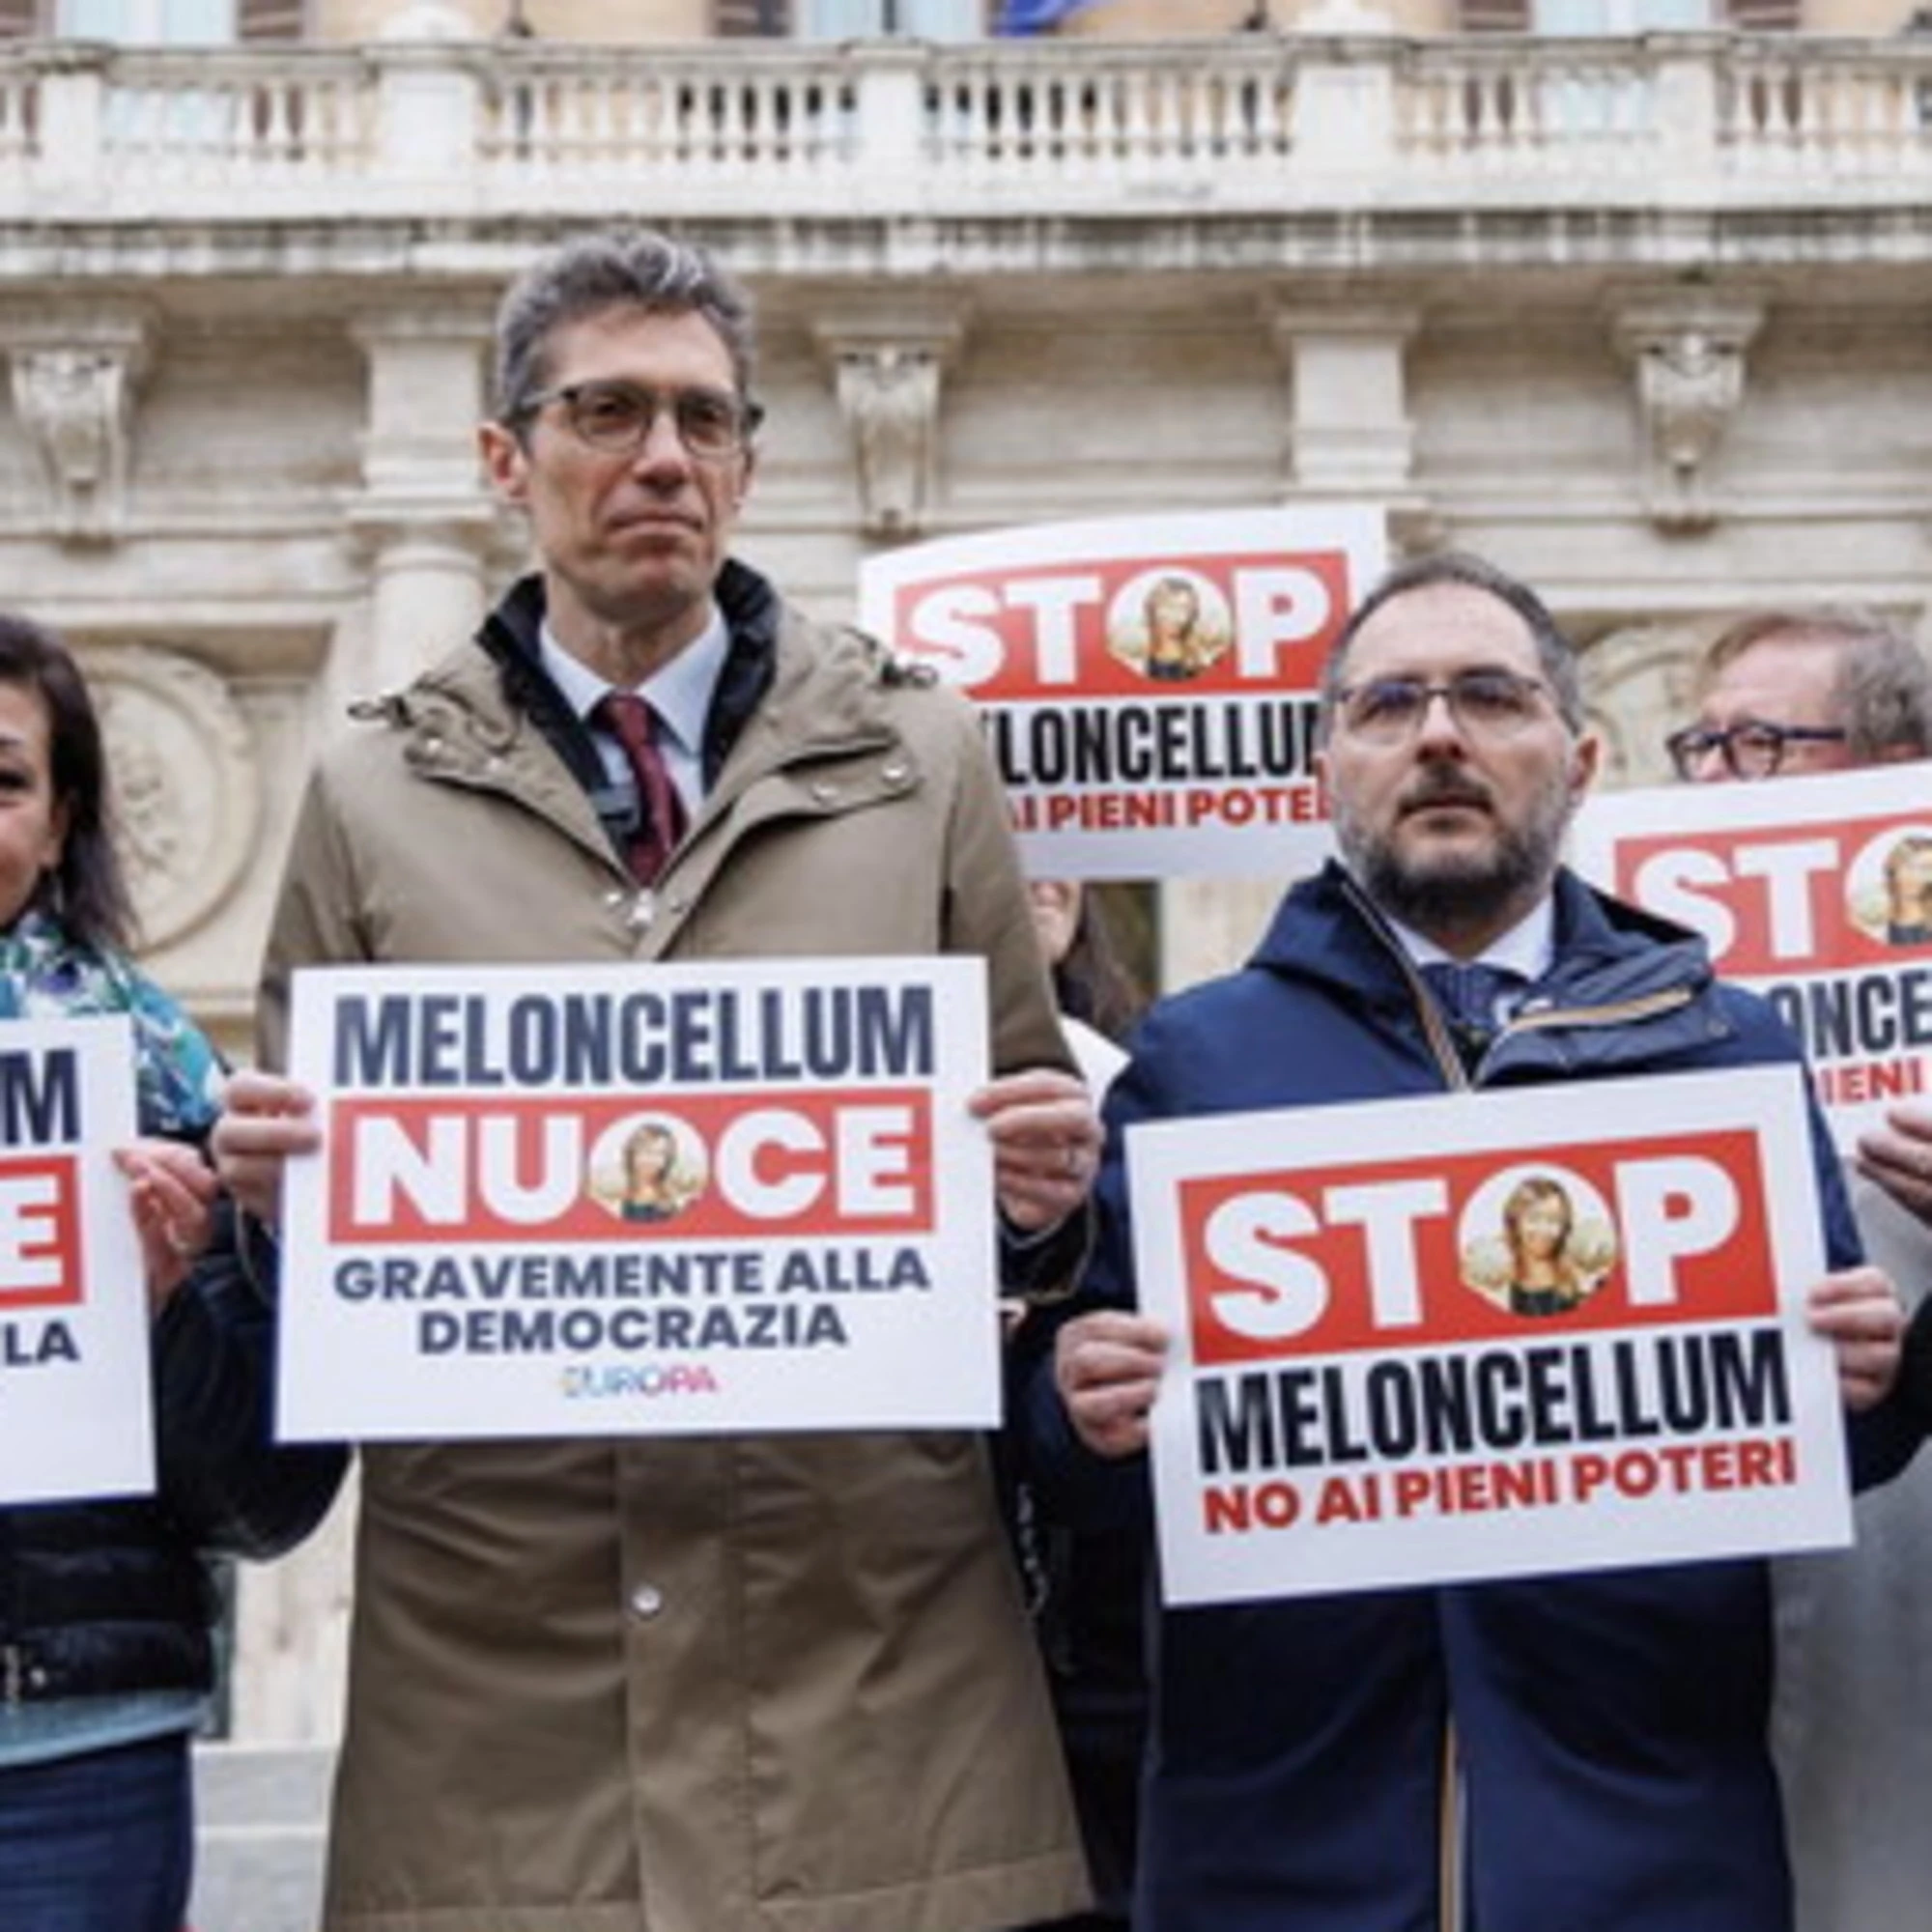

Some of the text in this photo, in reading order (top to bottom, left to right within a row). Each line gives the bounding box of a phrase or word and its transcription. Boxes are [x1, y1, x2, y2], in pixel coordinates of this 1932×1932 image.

[895, 565, 1331, 685] STOP
[980, 701, 1320, 785] LONCELLU
[1048, 787, 1176, 832] PIENI
[334, 985, 935, 1088] MELONCELLUM
[351, 1105, 918, 1227] NUOCE
[333, 1248, 930, 1301] GRAVEMENTE ALLA
[1204, 1154, 1740, 1340] STOP
[418, 1303, 847, 1355] DEMOCRAZIA
[558, 1364, 719, 1397] EUROPA
[1194, 1327, 1794, 1475] MELONCELLUM
[1203, 1436, 1798, 1534] NO AI PIENI POTERI
